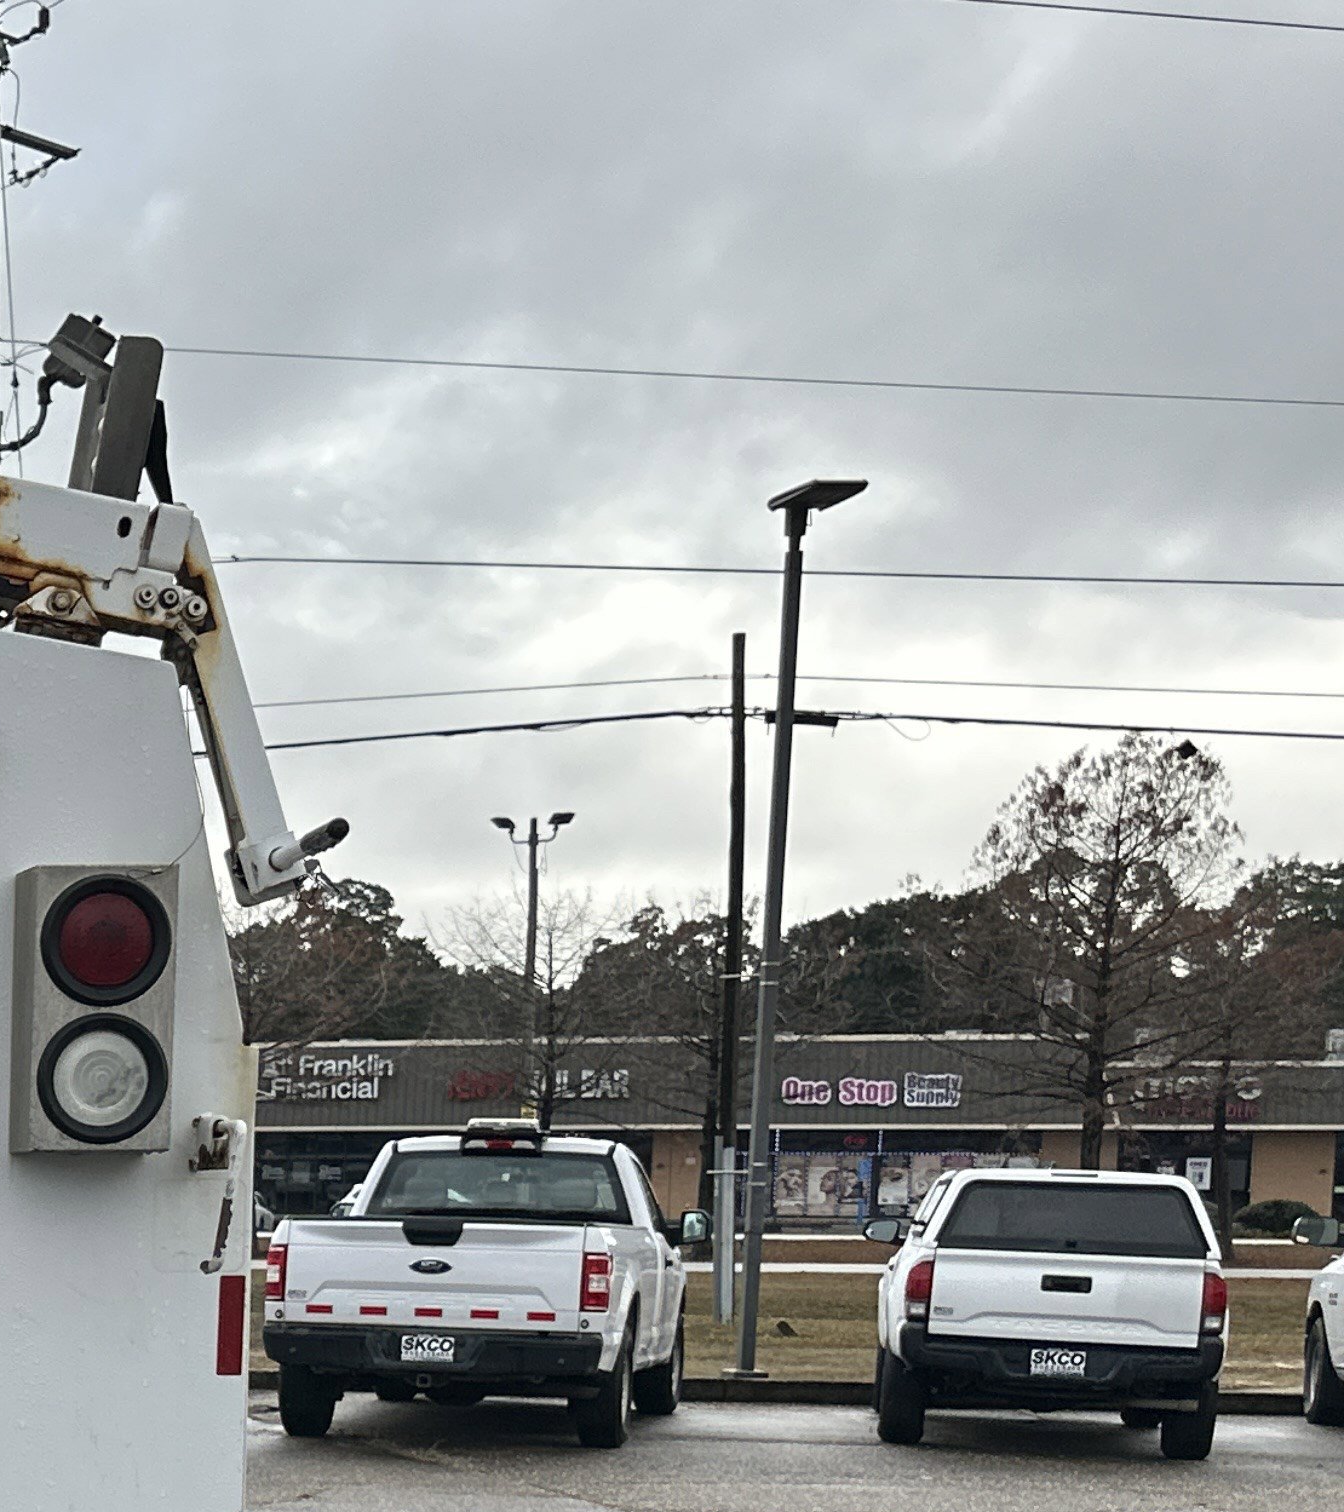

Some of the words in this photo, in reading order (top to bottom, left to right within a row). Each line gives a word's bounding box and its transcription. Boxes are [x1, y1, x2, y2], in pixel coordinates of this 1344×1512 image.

[298, 1054, 394, 1077] Franklin
[580, 1069, 629, 1099] BAR
[783, 1078, 830, 1104] One
[840, 1078, 896, 1105] Stop
[906, 1089, 960, 1104] Supply
[403, 1337, 454, 1352] SKCO
[1032, 1351, 1085, 1366] SKCO
